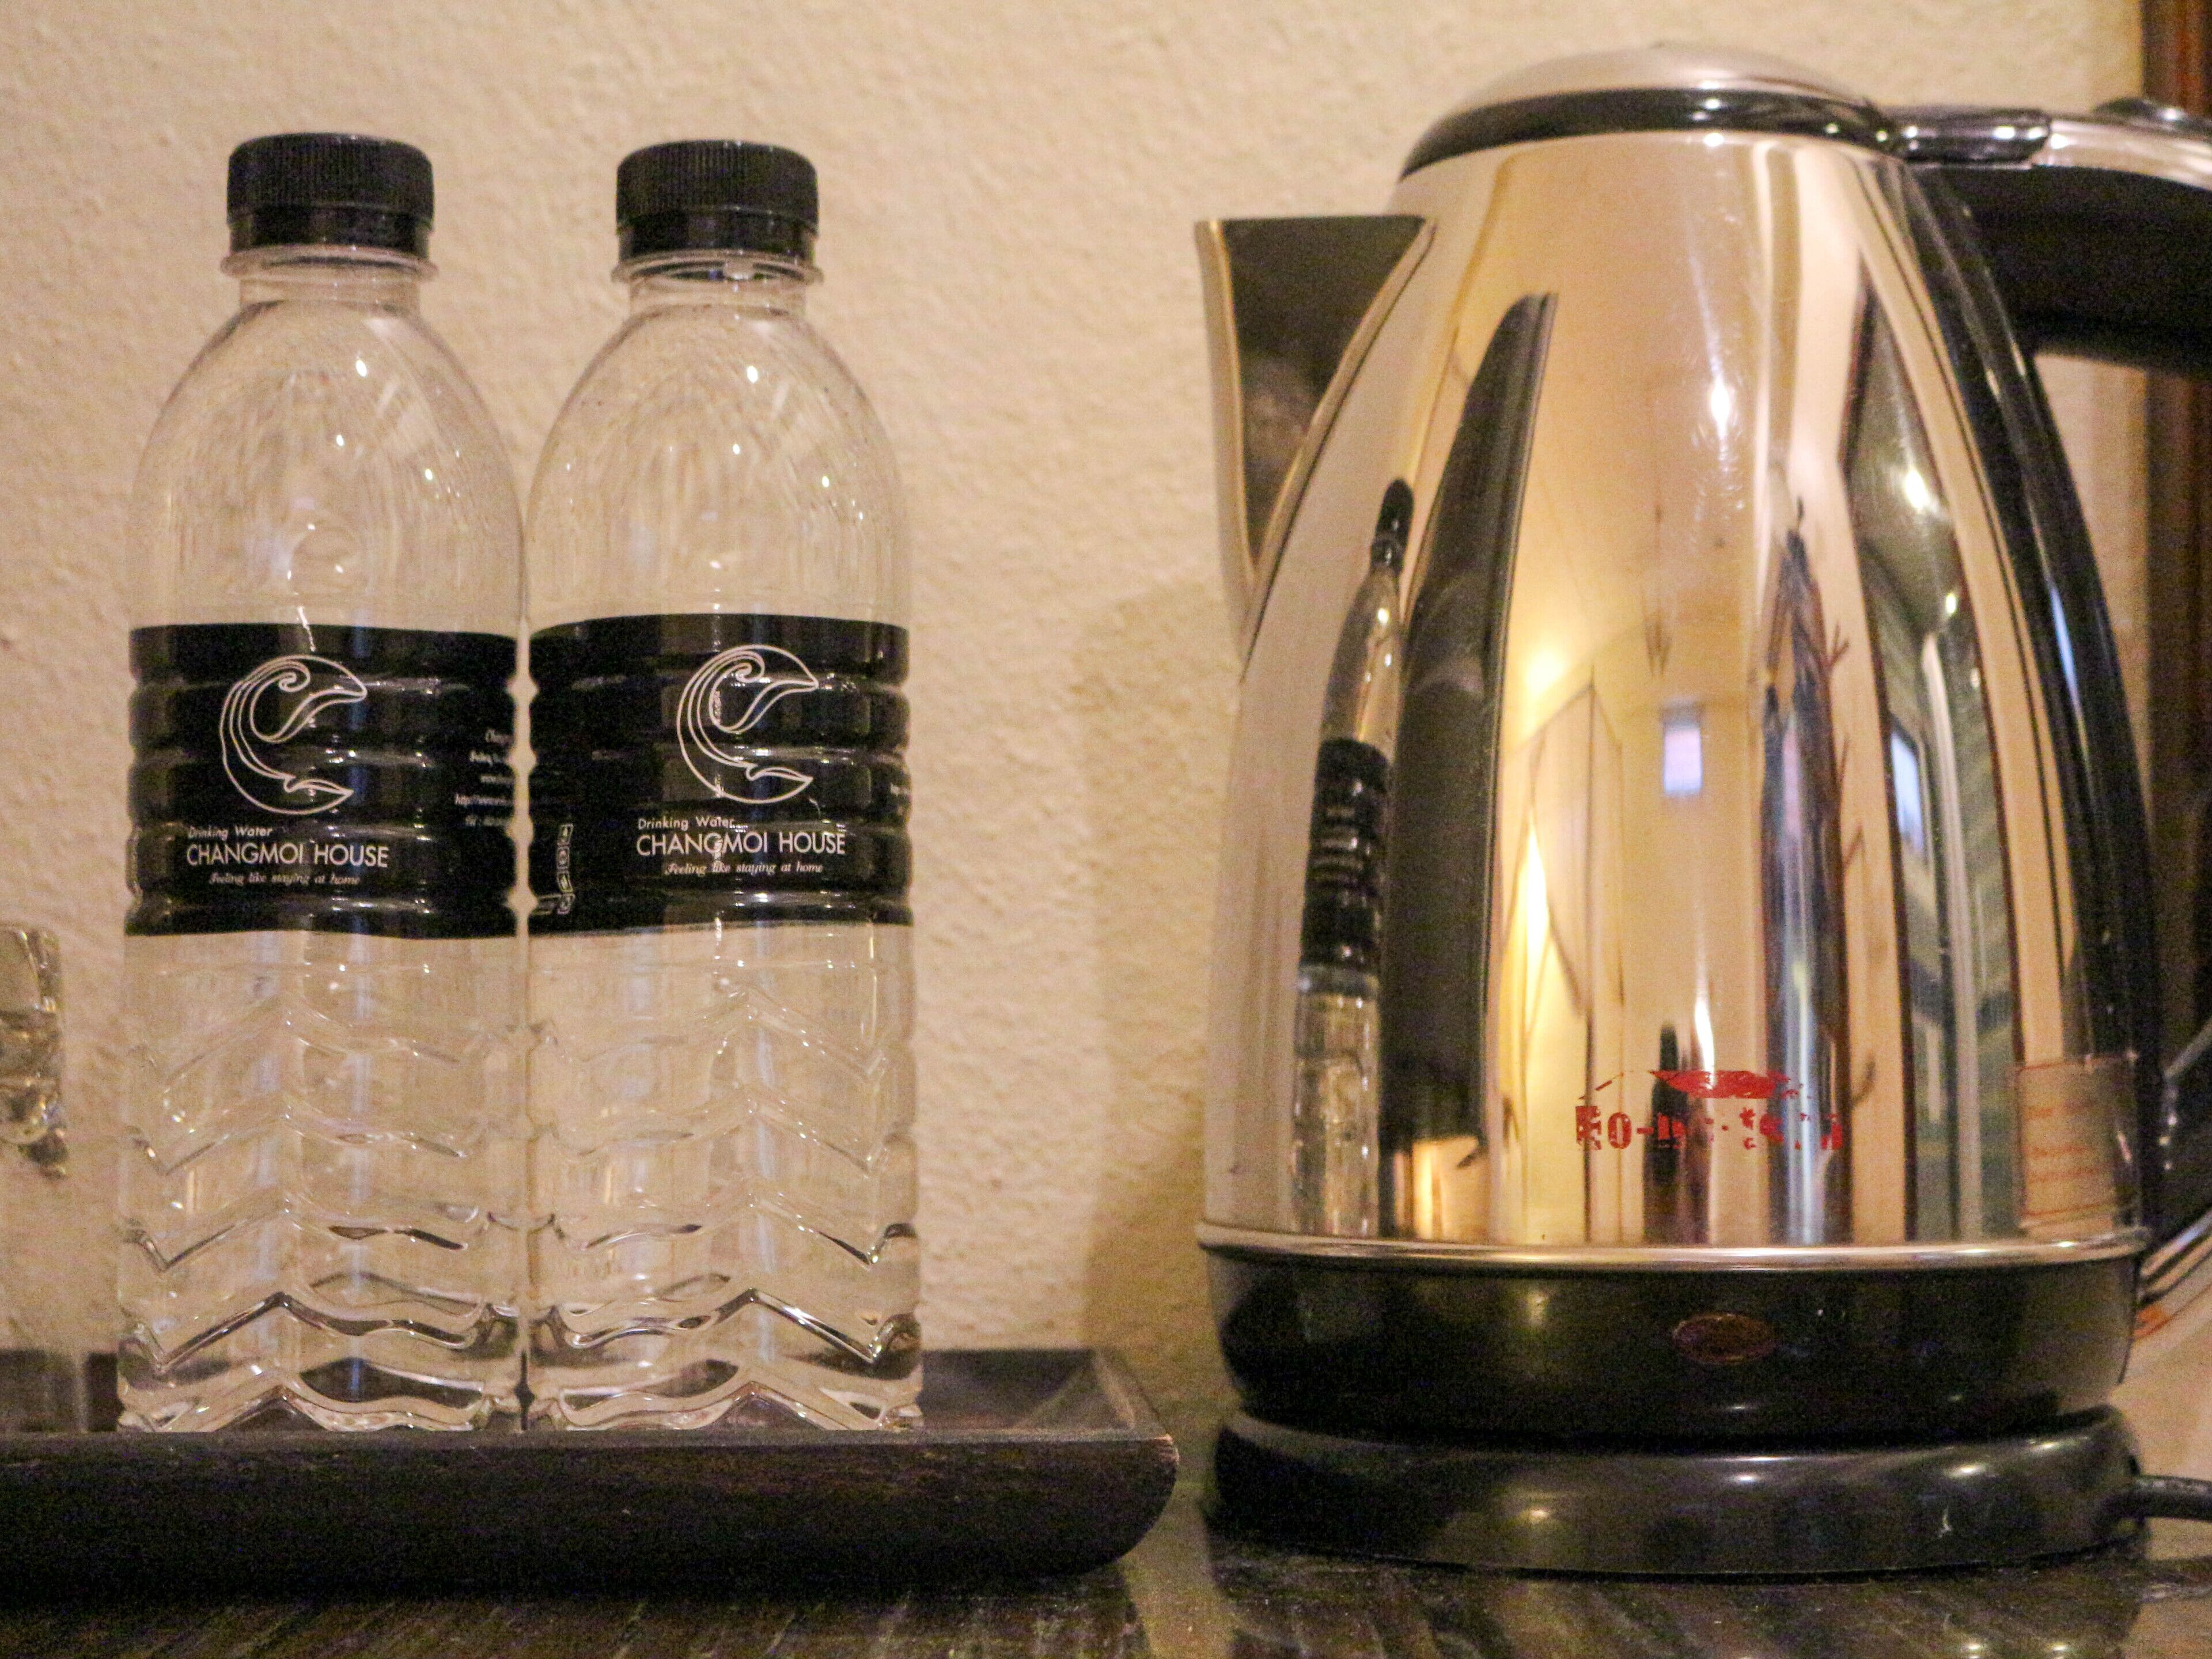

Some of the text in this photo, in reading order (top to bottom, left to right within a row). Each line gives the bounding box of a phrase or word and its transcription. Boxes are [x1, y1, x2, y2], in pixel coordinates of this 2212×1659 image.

[638, 816, 734, 831] Drinking Water
[188, 825, 272, 841] Drinking Water
[636, 832, 846, 856] CHANGMOI HOUSE
[187, 843, 389, 868] CHANGMOI HOUSE
[736, 863, 777, 875] staying
[781, 863, 793, 873] at
[797, 862, 823, 873] home
